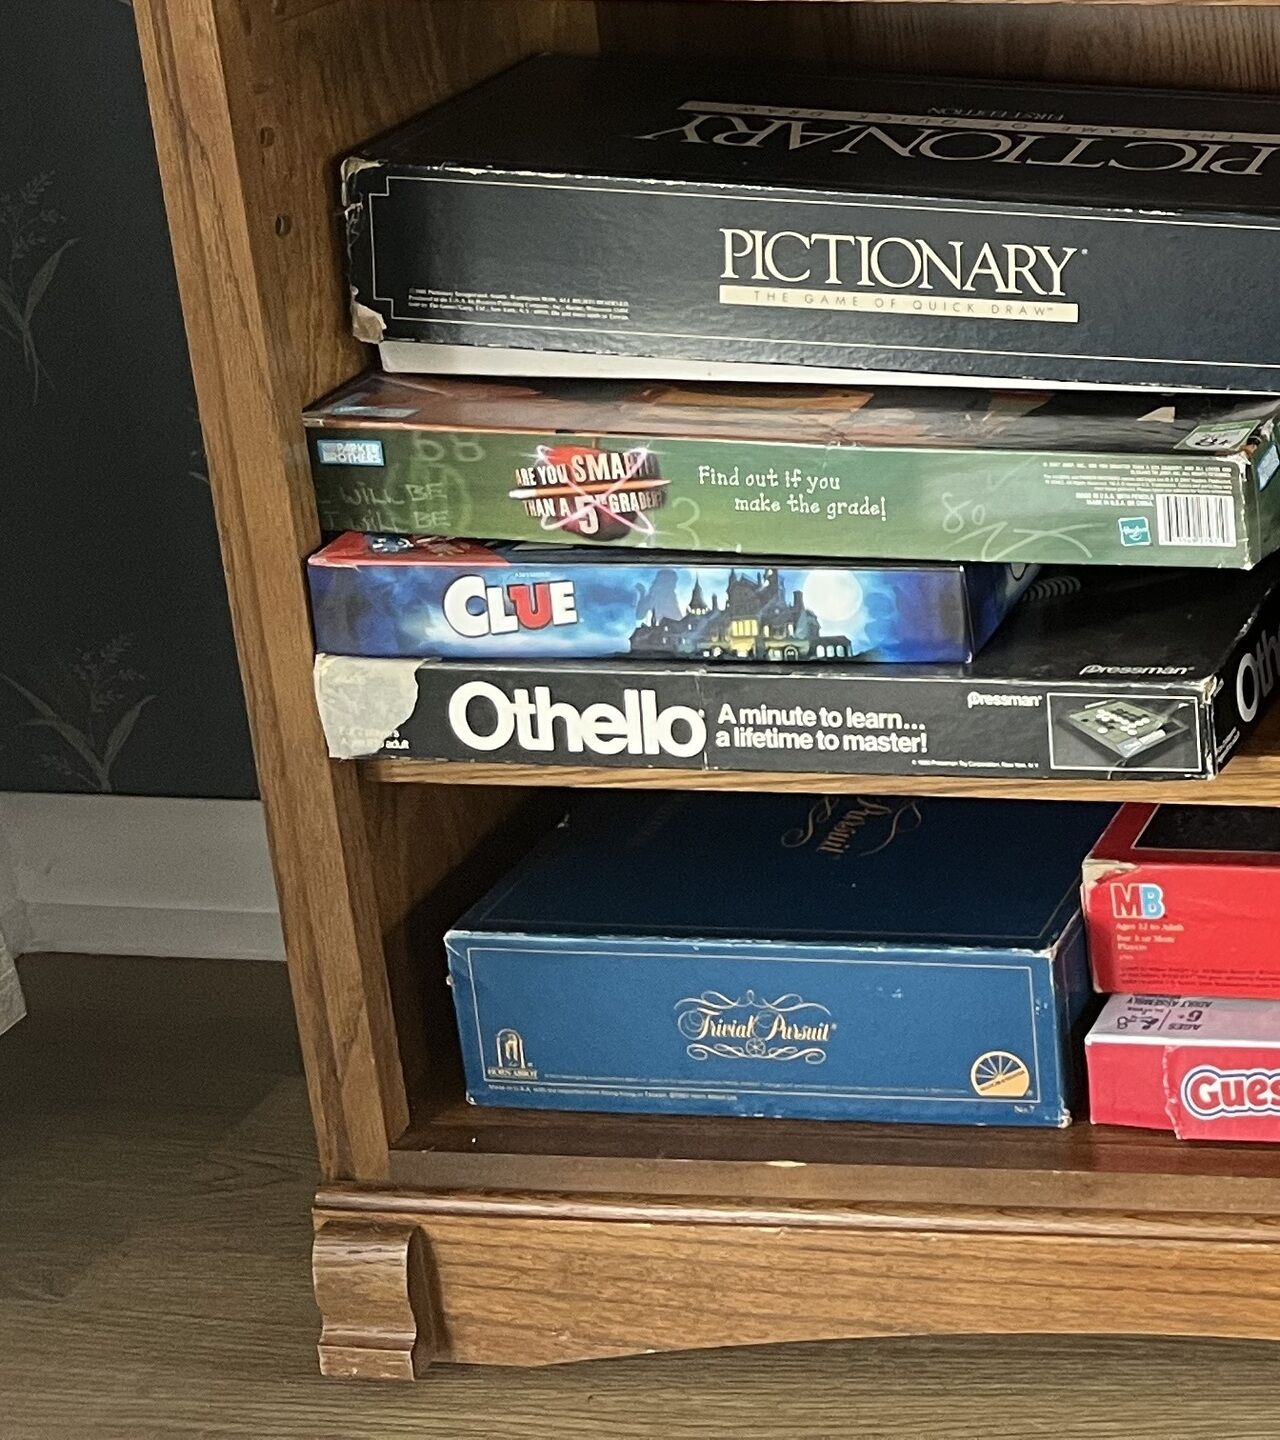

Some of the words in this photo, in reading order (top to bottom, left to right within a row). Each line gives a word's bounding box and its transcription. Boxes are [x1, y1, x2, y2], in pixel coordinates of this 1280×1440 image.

[719, 228, 1077, 296] PICTIONARY
[753, 291, 789, 302] THE
[804, 294, 859, 306] GAME
[874, 298, 897, 308] OF
[912, 299, 975, 313] QUICK
[991, 304, 1046, 316] DRAW
[443, 574, 578, 638] CLUE
[448, 681, 706, 757] Othello
[716, 704, 737, 724] A
[739, 705, 816, 727] minute
[819, 709, 842, 729] to
[846, 709, 925, 731] learn...
[716, 733, 730, 747] a
[731, 728, 814, 750] lifetime
[816, 733, 840, 752] to
[843, 732, 927, 754] master!
